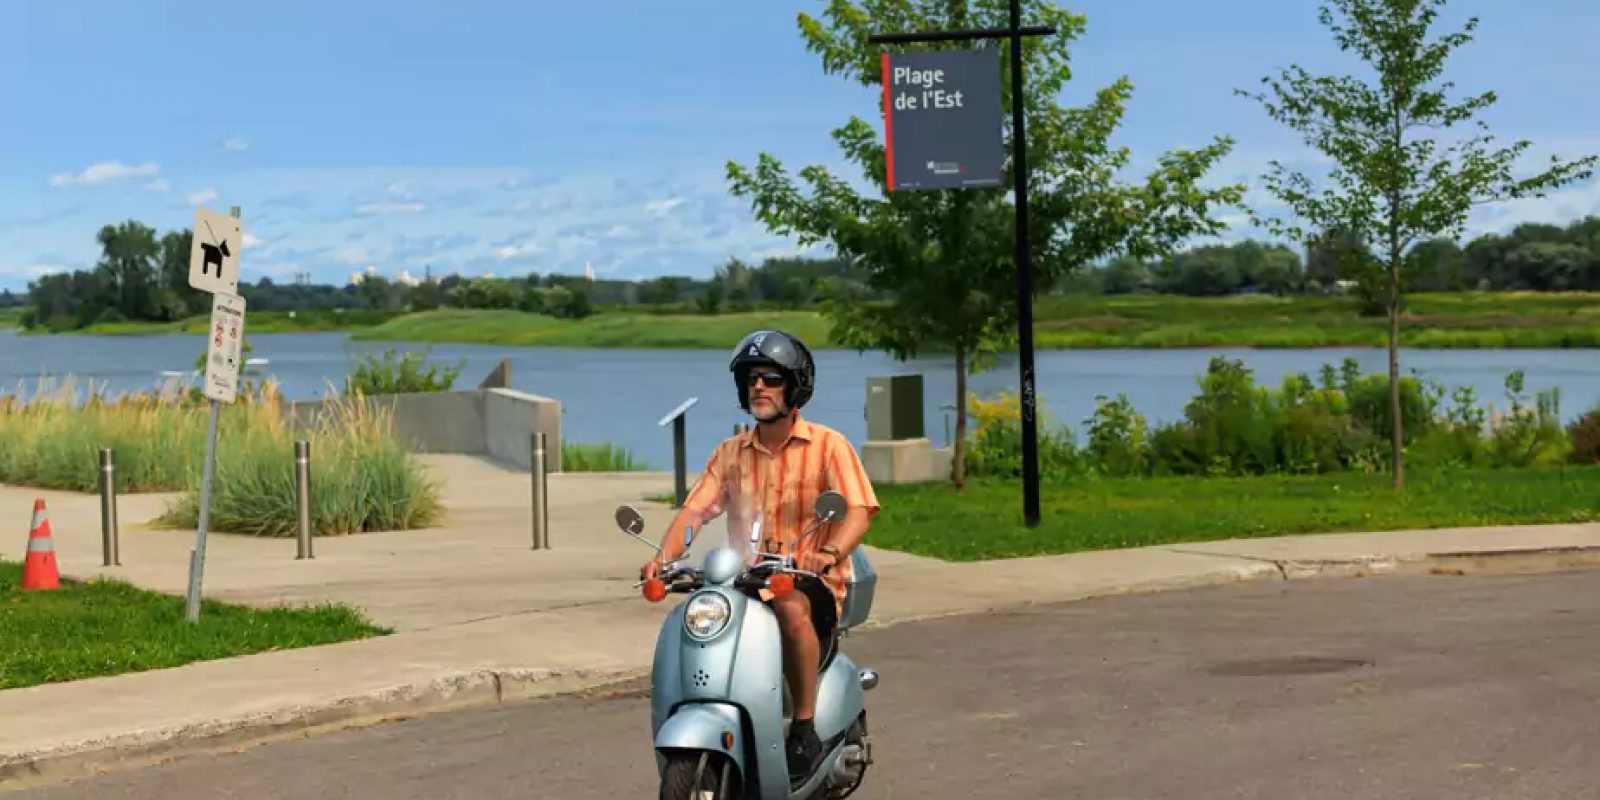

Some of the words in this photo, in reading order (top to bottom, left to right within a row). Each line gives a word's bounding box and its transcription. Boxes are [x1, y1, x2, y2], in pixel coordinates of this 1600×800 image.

[894, 66, 945, 88] Plage
[894, 91, 917, 110] de
[922, 89, 964, 109] l'Est
